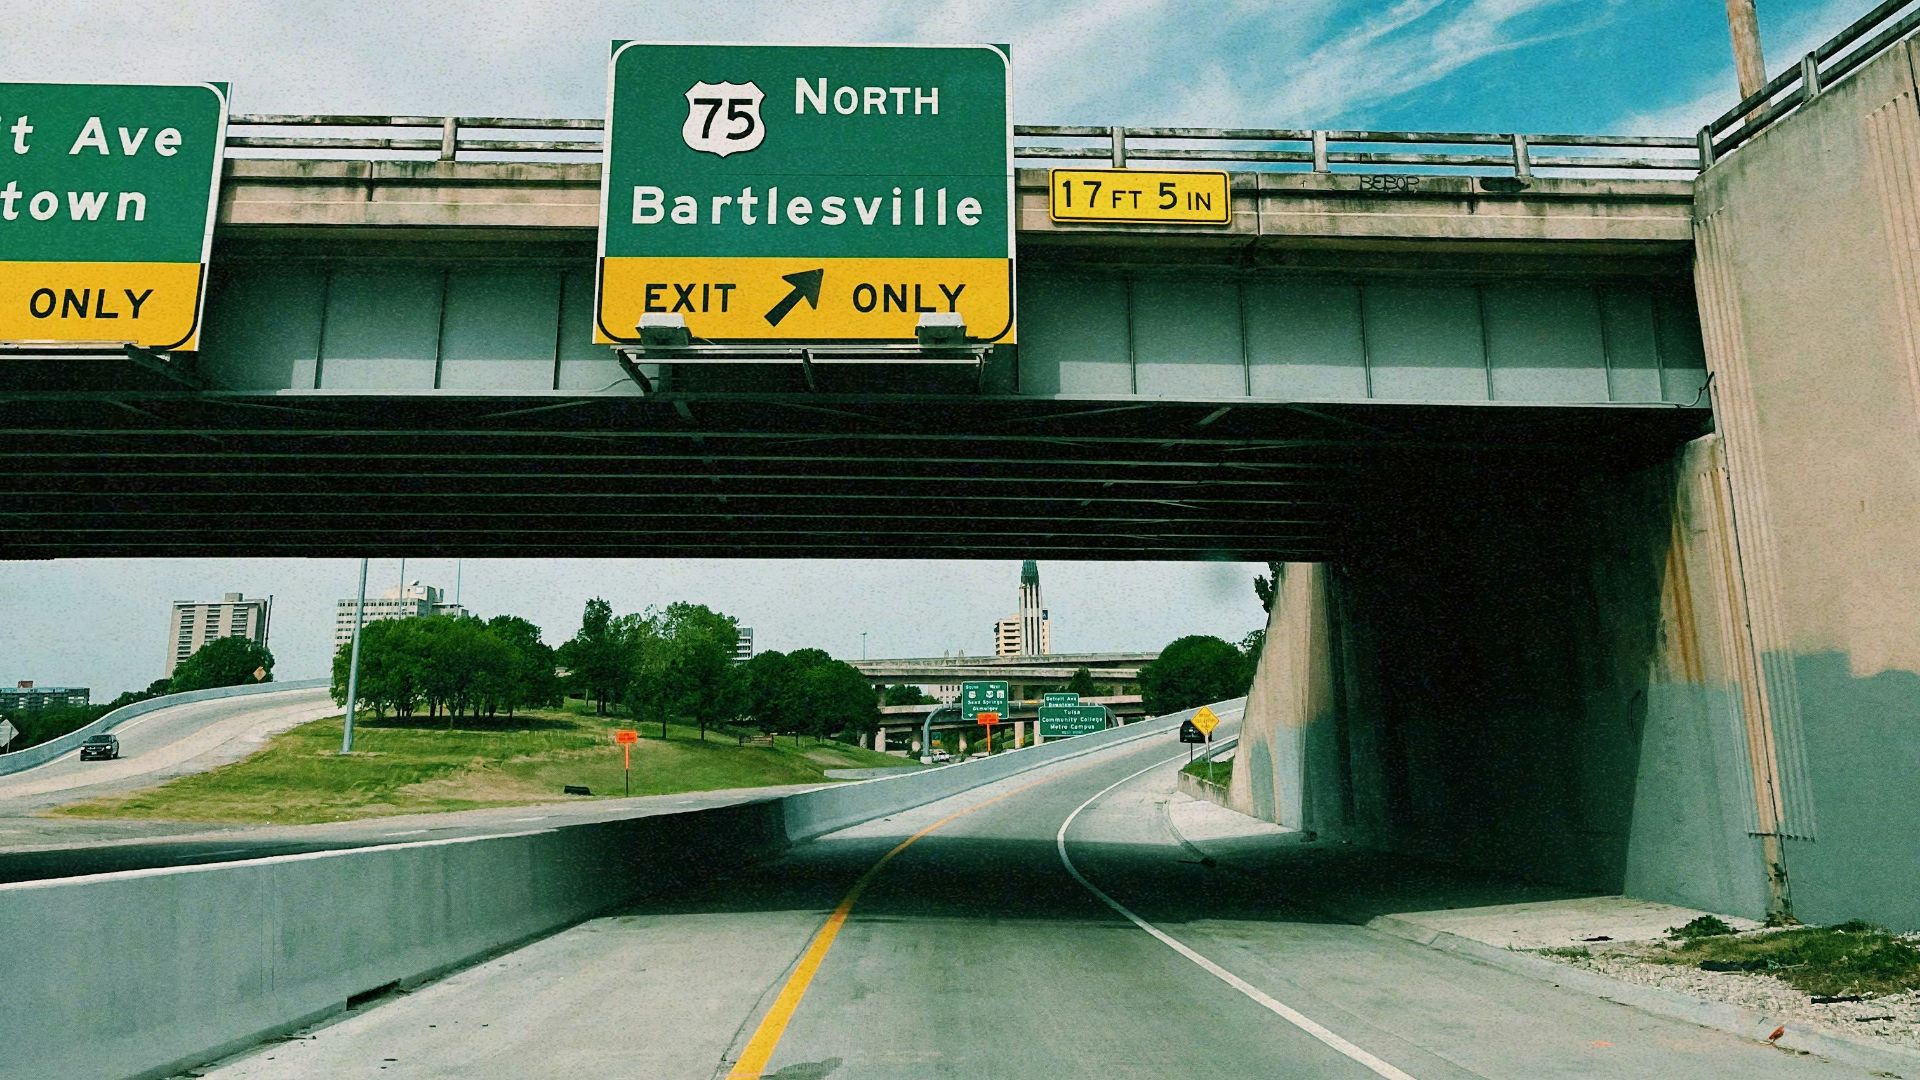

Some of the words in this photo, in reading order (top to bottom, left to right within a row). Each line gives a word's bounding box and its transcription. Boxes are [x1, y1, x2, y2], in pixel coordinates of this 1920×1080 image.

[795, 77, 939, 115] NORTH
[0, 115, 34, 155] t
[68, 116, 183, 157] Ave
[693, 98, 756, 141] 75
[0, 180, 147, 222] town
[632, 185, 983, 226] Bartlesville
[1062, 180, 1102, 208] 17
[1112, 190, 1142, 209] FT
[1158, 182, 1178, 210] 5
[1187, 191, 1211, 211] IN
[29, 287, 154, 319] ONLY
[645, 283, 737, 313] EXIT
[852, 283, 967, 314] ONLY
